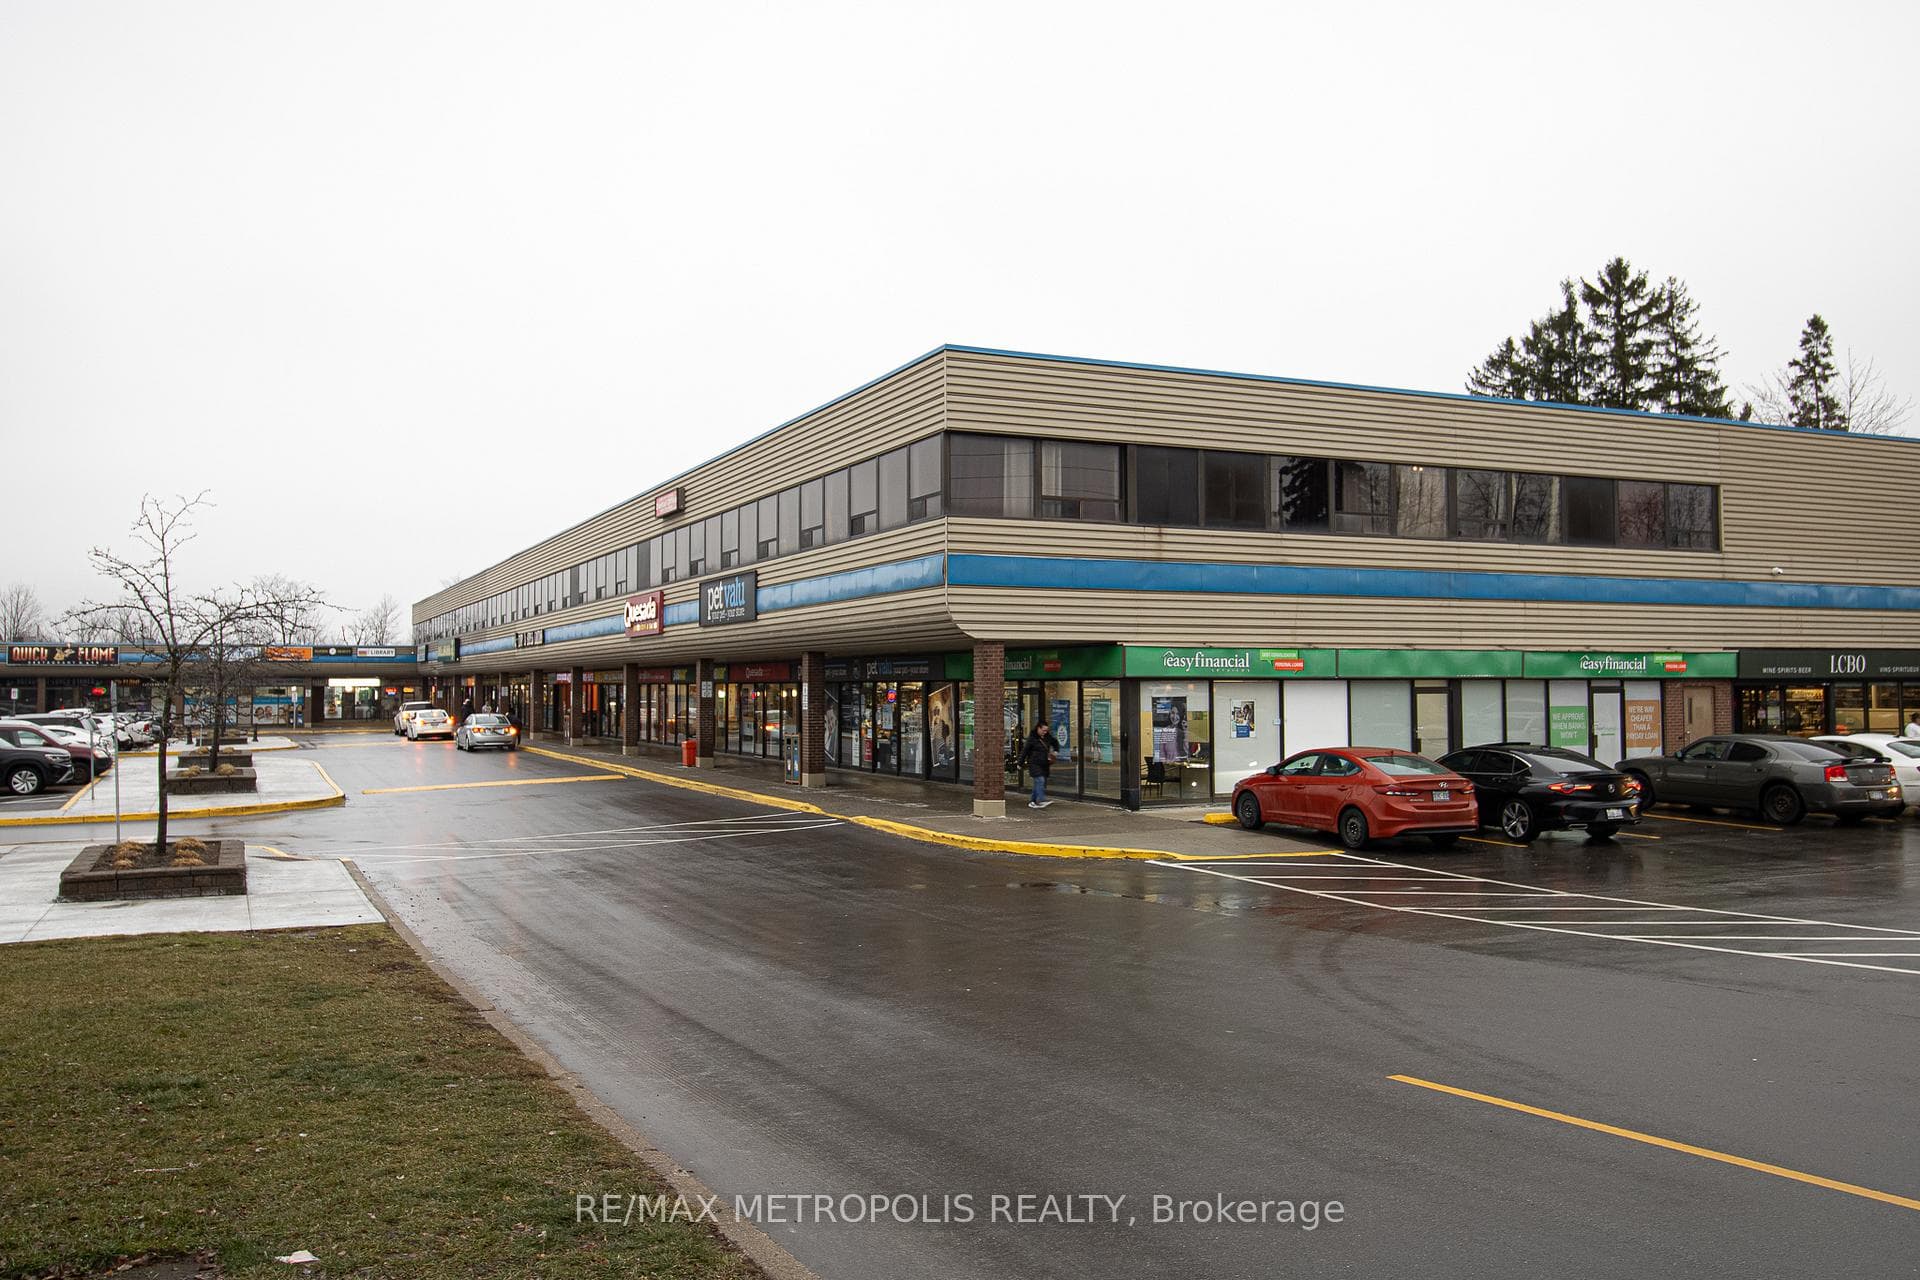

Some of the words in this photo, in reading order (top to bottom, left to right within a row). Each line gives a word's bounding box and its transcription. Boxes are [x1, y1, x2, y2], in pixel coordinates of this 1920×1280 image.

[708, 581, 724, 620] pet
[724, 576, 746, 608] valu
[624, 596, 657, 628] Quesada
[12, 647, 48, 661] QUICK
[78, 647, 115, 661] FLAME
[1164, 651, 1249, 672] easyfinancial
[1581, 655, 1646, 673] easyfinancial
[1830, 654, 1866, 673] LCBO
